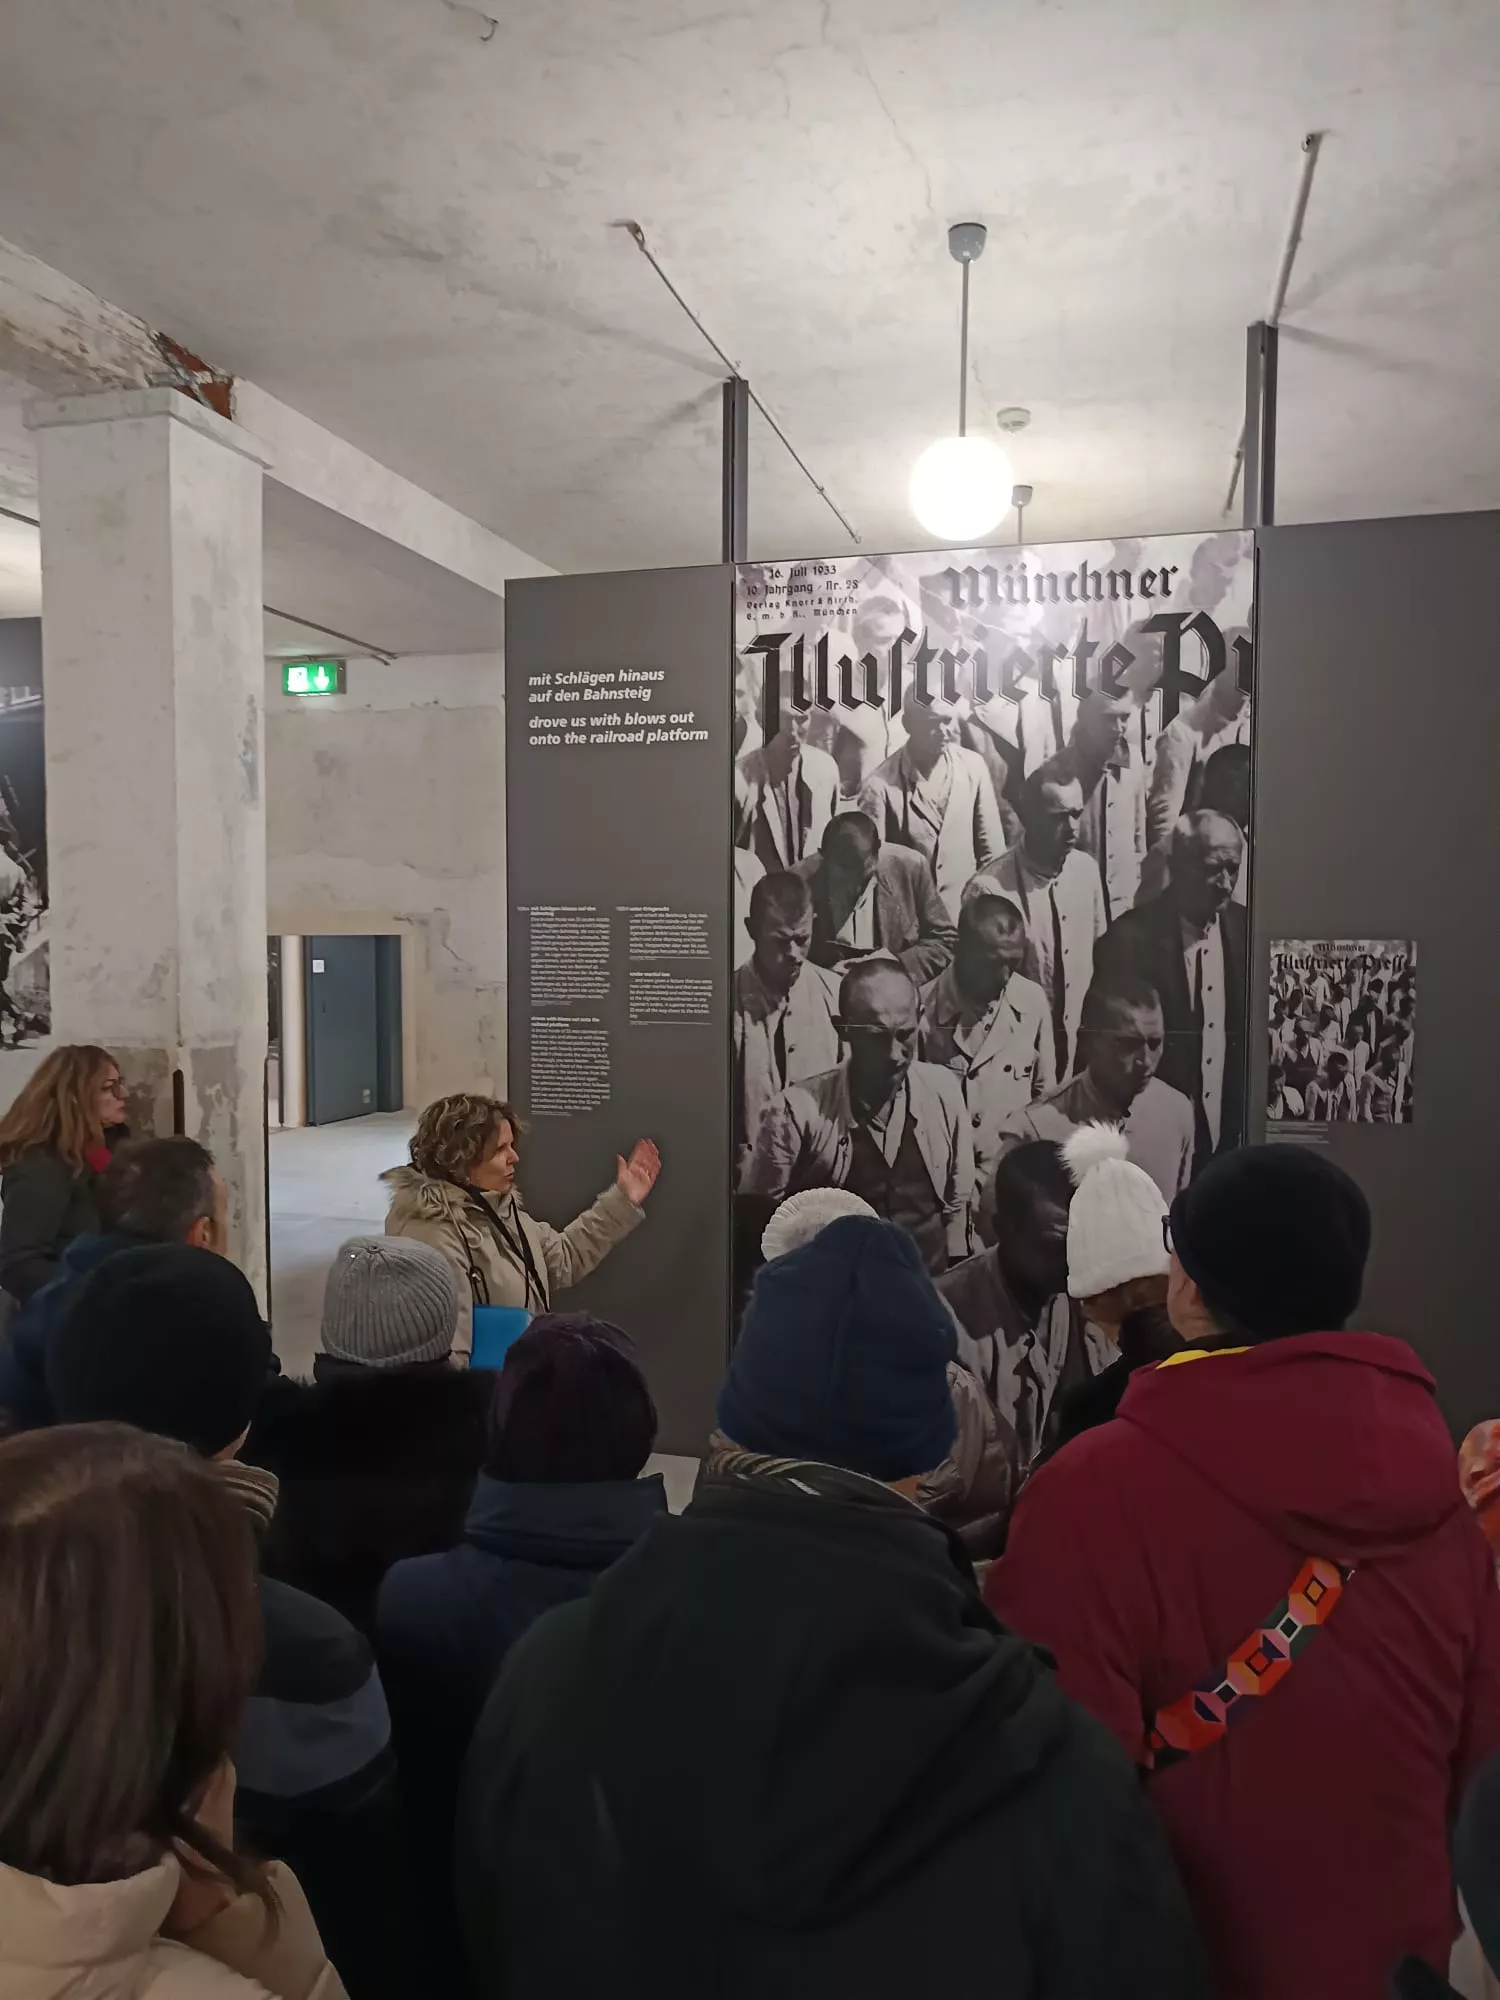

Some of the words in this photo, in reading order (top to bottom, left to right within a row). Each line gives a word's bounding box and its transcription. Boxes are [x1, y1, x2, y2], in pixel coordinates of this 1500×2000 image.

[812, 565, 837, 576] 1933
[765, 582, 813, 596] Jahrgang
[943, 559, 1179, 609] Münchner
[813, 607, 858, 617] München
[528, 673, 552, 686] mit
[554, 671, 615, 686] Schlägen
[618, 669, 665, 682] hinaus
[528, 689, 552, 703] auf
[554, 689, 580, 702] den
[583, 685, 652, 702] Bahnsteig
[528, 716, 568, 729] drove
[570, 717, 587, 727] us
[590, 713, 621, 727] with
[624, 712, 667, 725] blows
[669, 711, 695, 724] out
[529, 733, 561, 745] onto
[564, 731, 587, 744] the
[589, 729, 645, 743] railroad
[646, 727, 709, 744] platform
